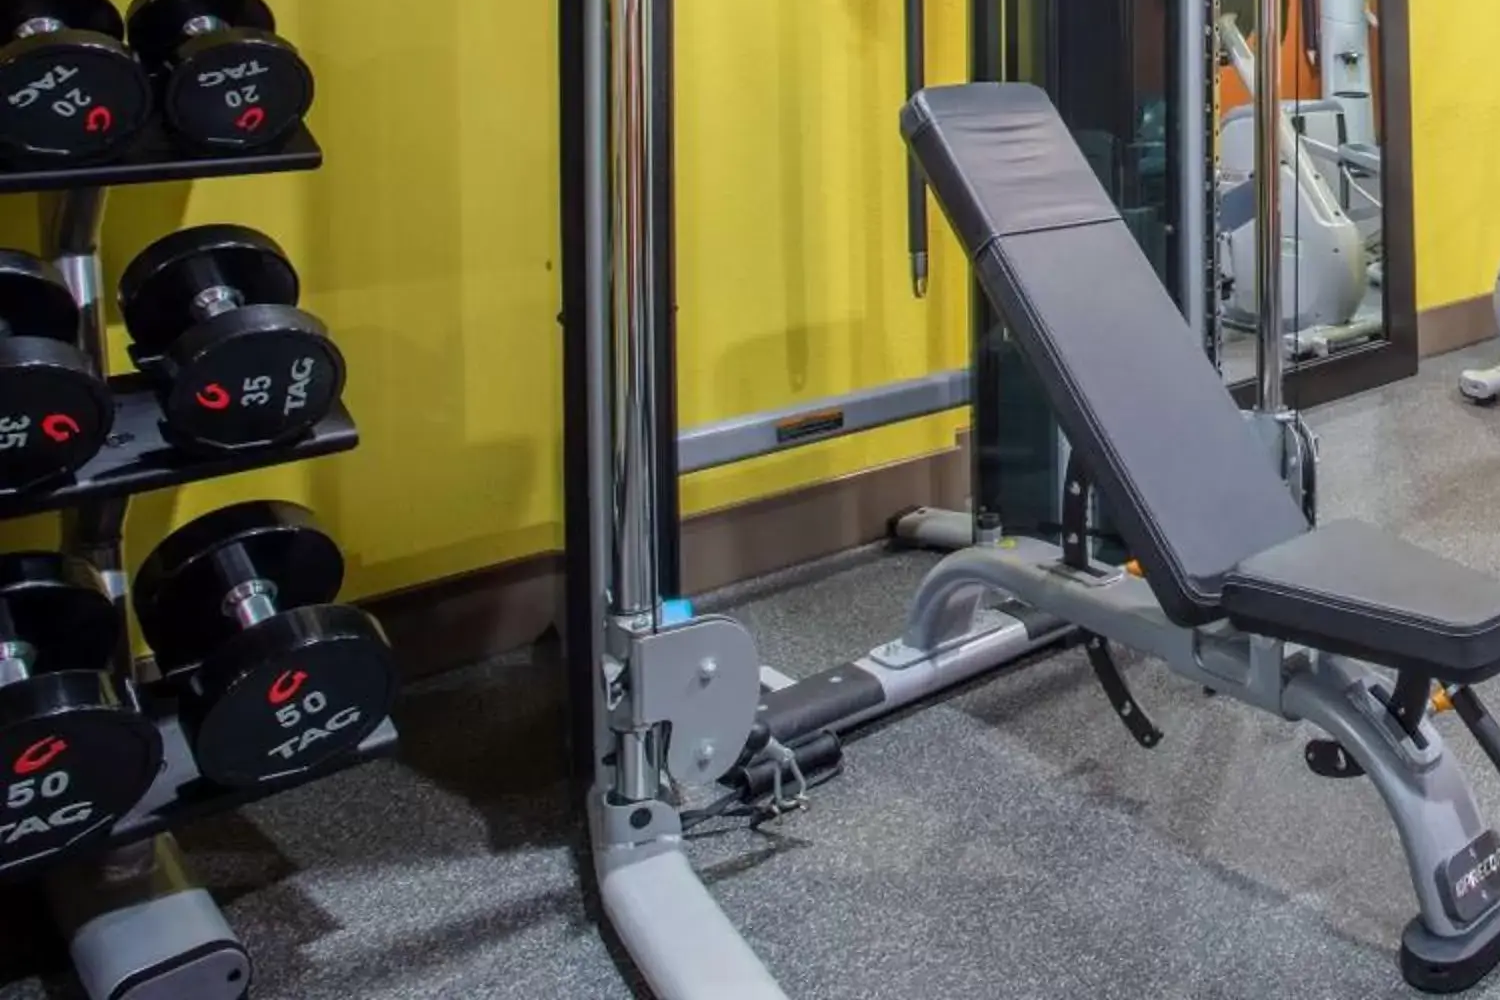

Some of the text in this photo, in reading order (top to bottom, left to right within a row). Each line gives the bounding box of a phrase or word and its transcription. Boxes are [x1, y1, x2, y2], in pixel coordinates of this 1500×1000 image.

[8, 65, 79, 107] TAG
[198, 60, 270, 87] TAG
[51, 87, 92, 117] 20
[225, 84, 260, 108] 20
[241, 357, 315, 416] 35 TAG
[0, 415, 31, 450] 35
[275, 690, 327, 728] 50
[267, 706, 361, 759] TAG
[7, 770, 69, 808] 50
